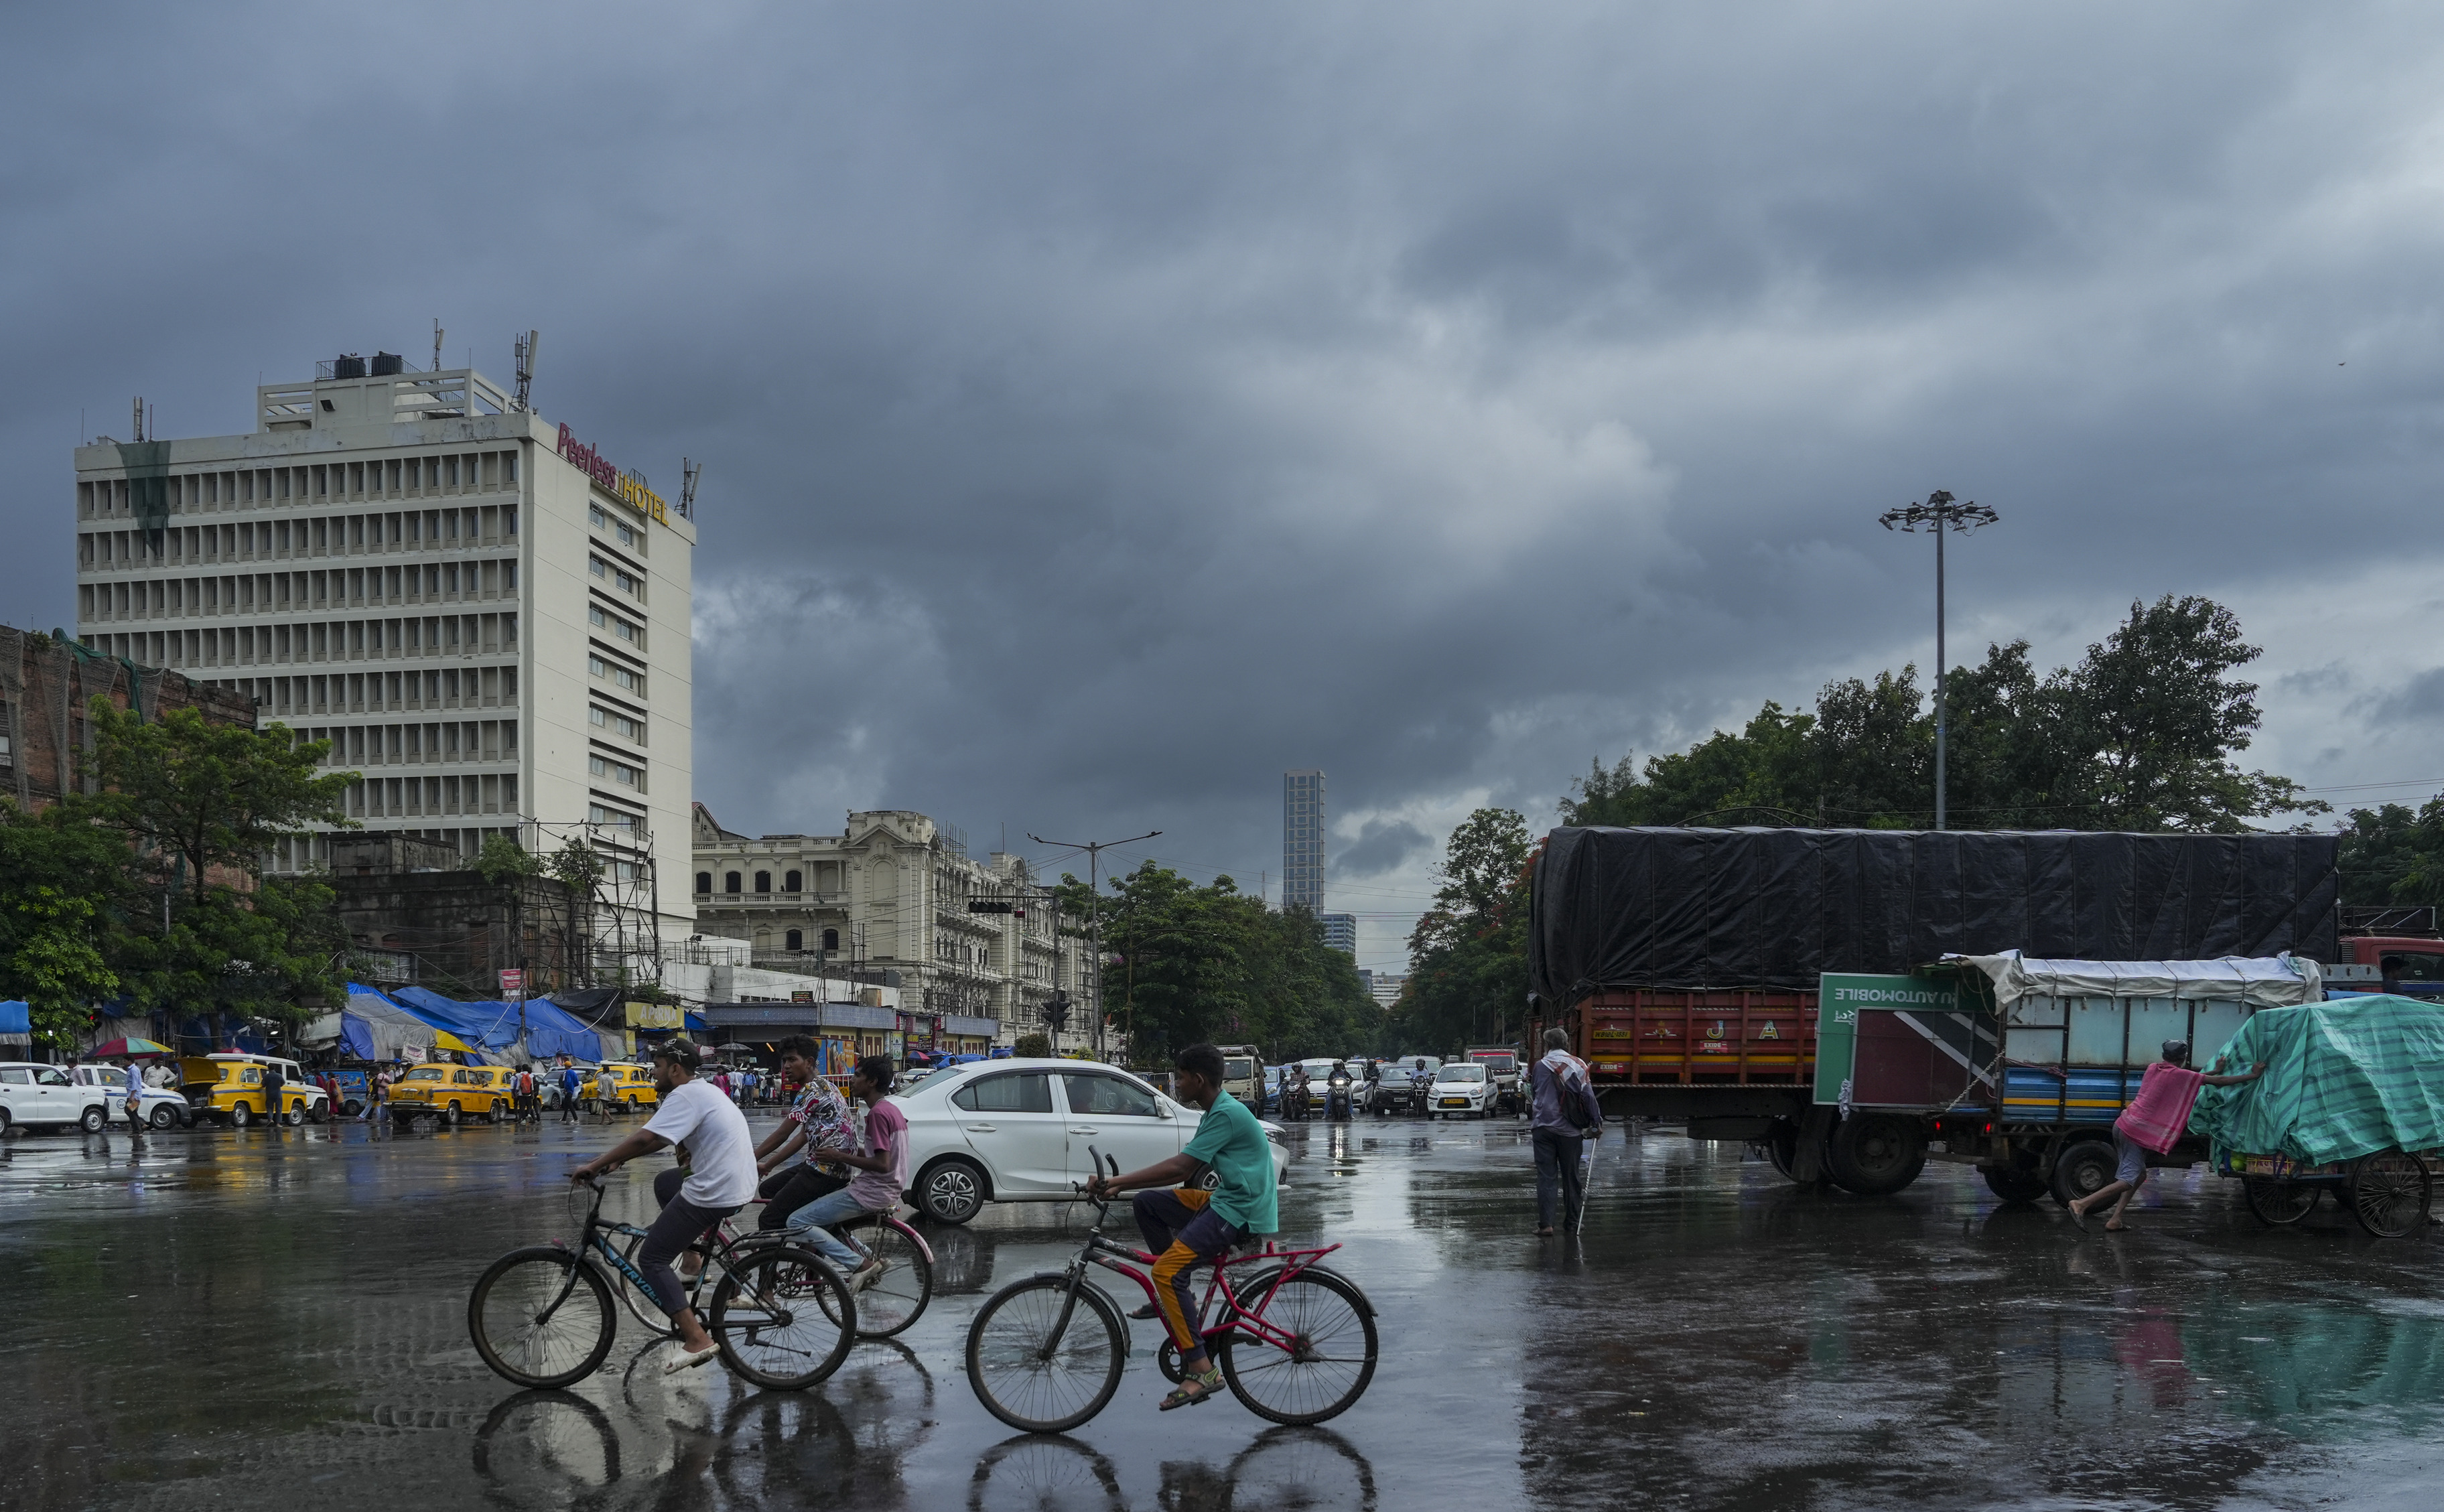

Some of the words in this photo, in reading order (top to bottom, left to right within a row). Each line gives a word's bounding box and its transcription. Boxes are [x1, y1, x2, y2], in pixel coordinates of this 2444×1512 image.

[557, 422, 617, 490] Peerless
[623, 474, 669, 527] HOTEL
[1835, 987, 1938, 1004] AUTOMOBILE
